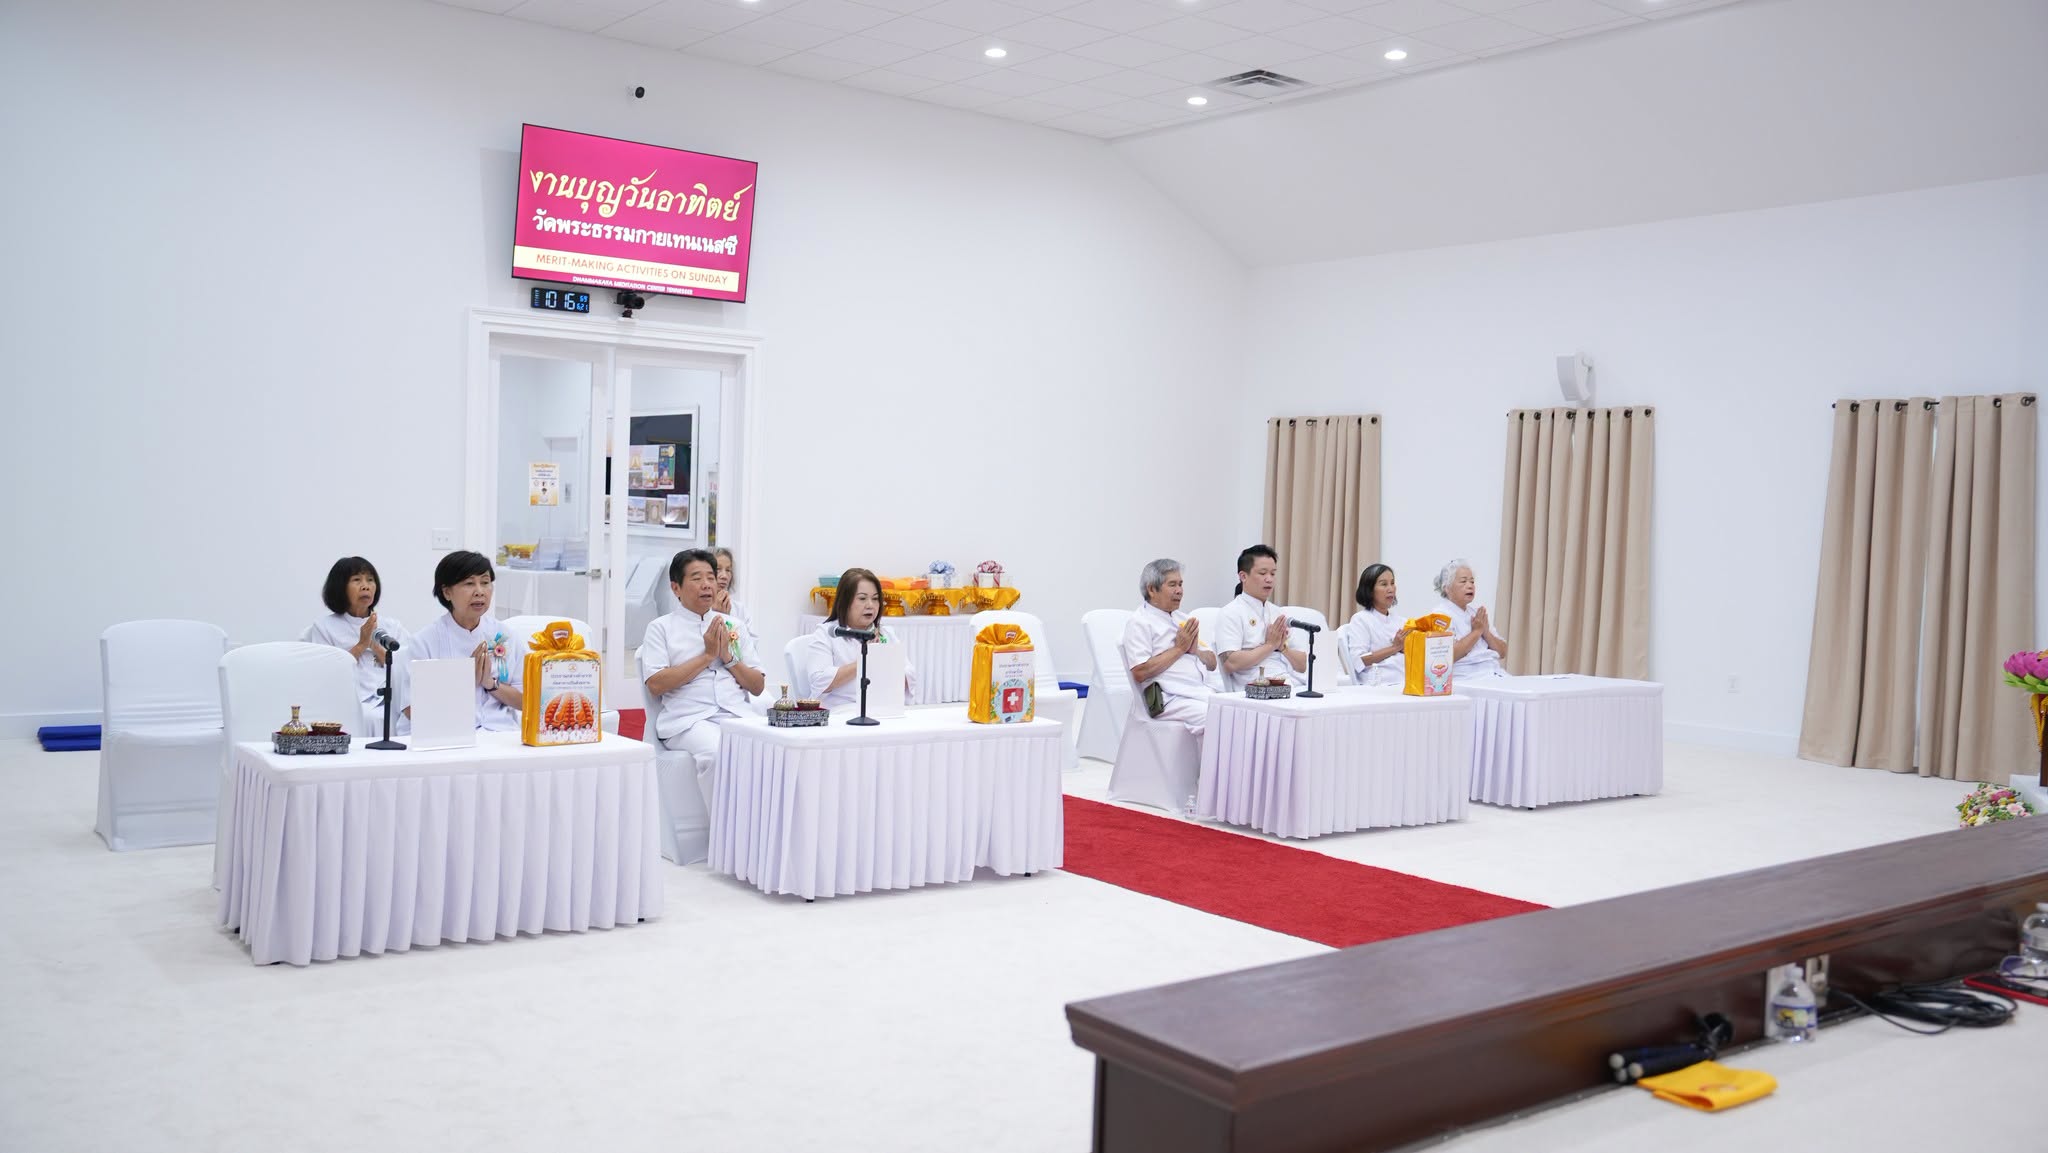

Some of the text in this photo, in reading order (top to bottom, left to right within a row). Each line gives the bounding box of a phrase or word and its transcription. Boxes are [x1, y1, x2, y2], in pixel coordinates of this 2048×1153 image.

[530, 168, 753, 222] งานบุญวันอาทิตย์
[532, 208, 739, 256] วัดพระธรรมกายเทนเนสซี
[536, 254, 728, 285] MERIT-MAKING ACTIVITIES ON SUNDAY
